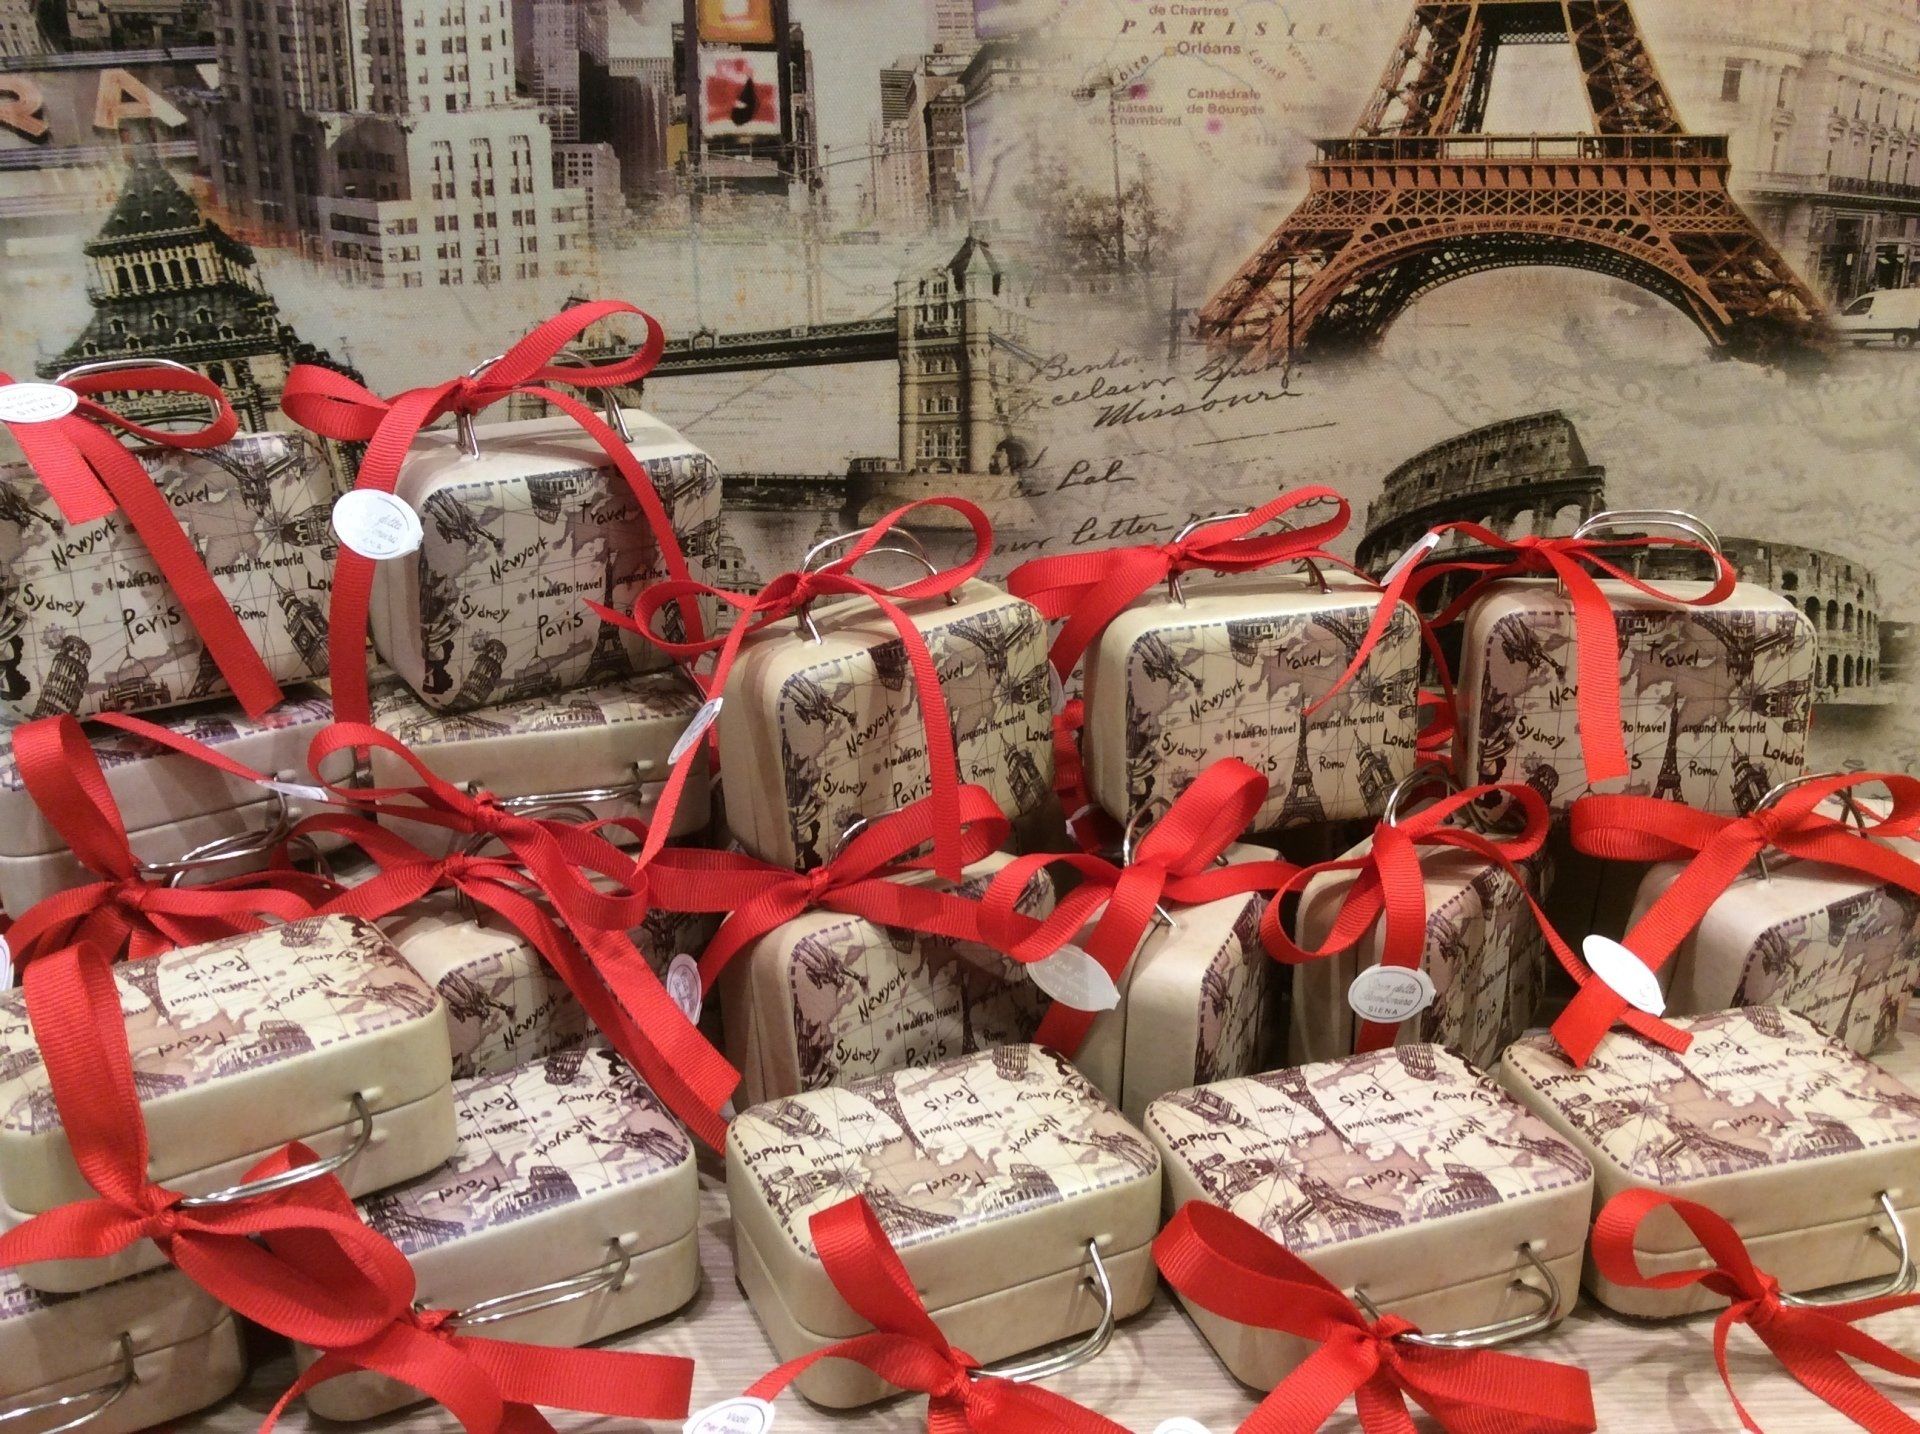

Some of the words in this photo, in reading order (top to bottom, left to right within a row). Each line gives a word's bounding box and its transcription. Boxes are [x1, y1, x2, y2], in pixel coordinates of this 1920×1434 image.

[1170, 4, 1230, 17] Chartres
[1176, 40, 1242, 56] Orléans
[577, 501, 630, 527] Travel
[213, 561, 251, 577] around
[254, 558, 272, 573] the
[274, 553, 304, 569] world
[490, 536, 549, 583] Newyork
[575, 577, 603, 594] travel
[23, 583, 86, 615] Sydney
[460, 594, 511, 623] Sydney
[121, 604, 182, 644] Paris
[537, 609, 584, 646] Paris
[1275, 647, 1322, 671] Travel
[1646, 641, 1700, 668] Travel
[1189, 678, 1246, 723] Newyork
[846, 704, 897, 760] Newyork
[961, 727, 988, 742] around
[989, 722, 1004, 735] the
[1004, 711, 1027, 730] world
[1270, 721, 1297, 737] travel
[1310, 716, 1342, 732] around
[1344, 714, 1359, 728] the
[1359, 712, 1386, 726] world
[1637, 720, 1667, 734] travel
[1682, 720, 1717, 735] around
[1719, 720, 1736, 735] the
[1738, 720, 1767, 735] world
[1516, 716, 1565, 750] Sydney
[1160, 731, 1208, 762] Sydney
[971, 764, 996, 781] Roma
[1318, 755, 1346, 772] Roma
[1689, 760, 1718, 778] Roma
[823, 773, 868, 797] Sydney
[294, 949, 361, 967] Sydney
[185, 953, 250, 985] Paris
[169, 990, 209, 1007] travel
[858, 967, 908, 1023] Newyork
[936, 1001, 960, 1019] travel
[1368, 1004, 1398, 1016] SIENA
[158, 1030, 229, 1058] Travel
[835, 1040, 881, 1068] Sydney
[1693, 1039, 1749, 1061] Paris
[1532, 1073, 1595, 1090] London
[556, 1089, 617, 1107] Sydney
[923, 1084, 979, 1113] Paris
[1016, 1088, 1075, 1105] Sydney
[1338, 1082, 1396, 1108] Paris
[1432, 1091, 1493, 1107] Sydney
[459, 1091, 518, 1121] Paris
[1257, 1102, 1293, 1117] Roma
[838, 1110, 875, 1124] Roma
[1342, 1118, 1377, 1134] travel
[919, 1121, 953, 1139] travel
[1290, 1128, 1328, 1145] around
[866, 1135, 902, 1153] around
[1169, 1131, 1231, 1152] London
[1240, 1141, 1270, 1156] world
[1270, 1135, 1289, 1149] the
[744, 1143, 804, 1166] London
[810, 1151, 844, 1167] world
[845, 1146, 865, 1159] the
[924, 1169, 990, 1195] Travel
[1362, 1168, 1429, 1189] Travel
[437, 1174, 503, 1204] Travel
